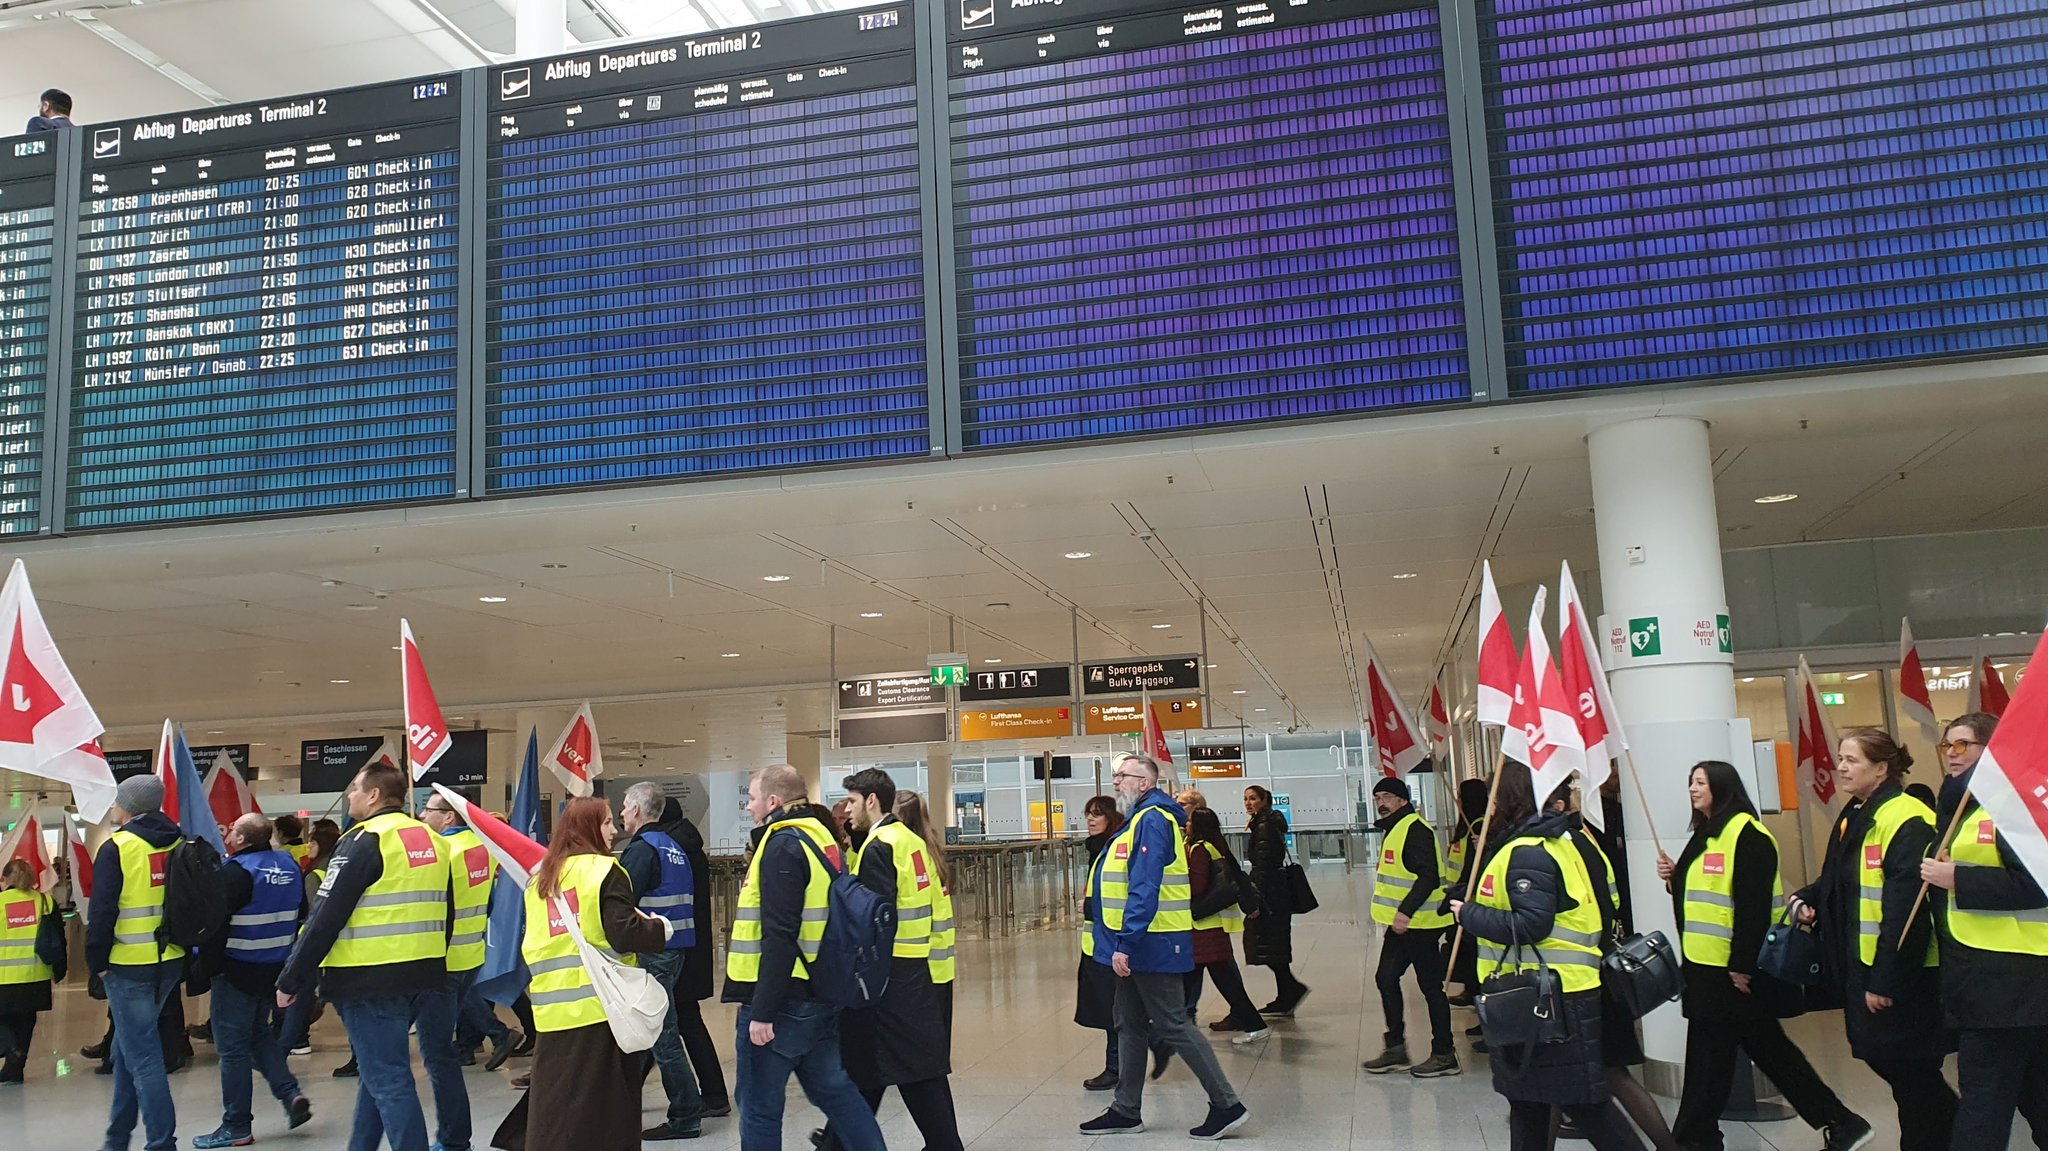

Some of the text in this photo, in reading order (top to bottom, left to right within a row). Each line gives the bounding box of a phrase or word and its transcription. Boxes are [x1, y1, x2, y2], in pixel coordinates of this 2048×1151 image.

[858, 11, 898, 31] 12:24
[963, 14, 1275, 56] Flug nach über scheduled estimated
[545, 32, 761, 80] Abflug Departures Terminal 2
[964, 58, 983, 69] Flight
[1098, 40, 1109, 48] via
[787, 73, 803, 83] Gate
[413, 82, 447, 100] 12:24
[501, 89, 773, 125] Flug nach über scheduled estimated
[134, 98, 327, 141] Abflug Departures Terminal 2
[501, 111, 629, 137] Flight to via
[14, 140, 45, 157] 12:24
[348, 138, 362, 147] Gate
[92, 153, 335, 182] Flug nach über scheduled estimated
[92, 184, 109, 194] Flight
[198, 171, 208, 179] via
[92, 201, 105, 213] SK
[112, 196, 138, 211] 2658
[152, 186, 218, 206] Kopenhagen
[266, 175, 300, 191] 20:25
[376, 157, 432, 176] Check-in
[92, 220, 105, 232] LH
[118, 216, 136, 225] 121
[151, 208, 210, 225] Frankfurt
[266, 194, 299, 210] 21:00
[376, 178, 431, 196] Check-in
[90, 238, 104, 251] LX
[111, 234, 136, 248] 1111
[150, 228, 190, 245] Zürich
[264, 214, 298, 230] 21:00
[374, 198, 431, 215] Check-in
[90, 214, 444, 270] OU 437 Zagreb 21:15 annulliert
[88, 278, 101, 290] LH
[108, 272, 135, 288] 2486
[149, 268, 188, 283] London
[264, 253, 297, 269] 21:50
[346, 244, 367, 259] H30
[374, 236, 430, 255] Check-in
[88, 296, 101, 309] LH
[108, 292, 134, 307] 2152
[148, 284, 207, 303] Stuttgart
[262, 272, 297, 289] 21:50
[373, 257, 430, 275] Check-in
[87, 277, 429, 328] LH 726 Shanghai 22:05 H44 Check-in
[86, 335, 99, 348] LH
[112, 331, 133, 345] 772
[146, 326, 193, 342] Bangkok
[261, 312, 296, 329] 22:10
[344, 304, 365, 319] H48
[372, 298, 429, 316] Check-in
[86, 354, 99, 368] LH
[106, 351, 132, 366] 1992
[145, 348, 173, 362] Köln
[180, 344, 185, 358] /
[192, 342, 220, 357] Bonn
[260, 332, 295, 348] 22:20
[372, 318, 429, 336] Check-in
[84, 374, 98, 387] LH
[104, 370, 131, 385] 2142
[144, 365, 191, 381] Münster
[199, 362, 205, 375] /
[260, 352, 295, 369] 22:25
[371, 338, 428, 357] Check-in
[1612, 628, 1622, 636] AED
[1694, 630, 1715, 638] Notruf
[1700, 638, 1711, 646] 112
[1108, 663, 1164, 676] Sperrgepäck
[878, 686, 930, 696] Customs Clearance
[1108, 676, 1174, 688] Bulky Baggage
[878, 694, 932, 705] Export Certification
[990, 712, 1022, 720] Lufthansa
[1102, 706, 1135, 714] Lufthansa
[1103, 712, 1144, 721] Service Cent
[324, 744, 368, 754] Geschlossen
[324, 756, 347, 765] Closed
[459, 774, 470, 782] 0-3
[408, 848, 435, 859] ver.di
[470, 867, 488, 879] ver.di
[8, 915, 35, 924] ver.di
